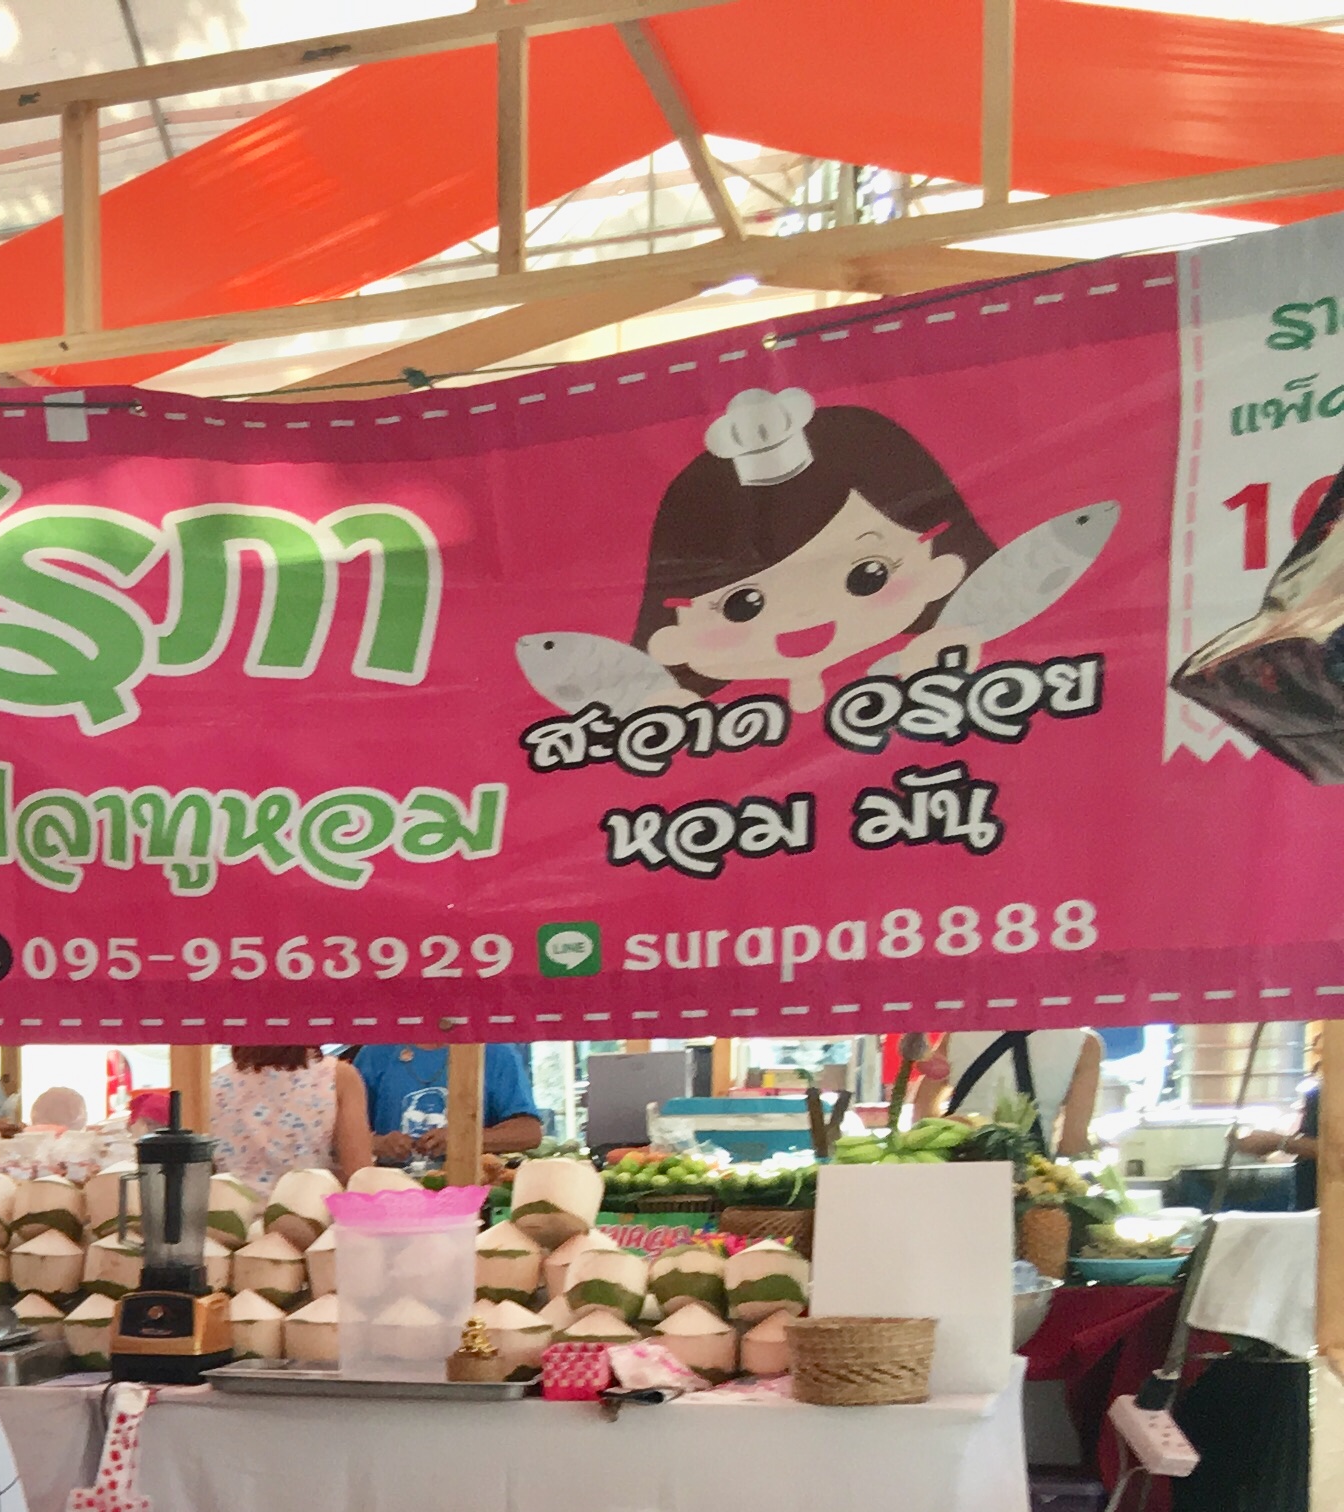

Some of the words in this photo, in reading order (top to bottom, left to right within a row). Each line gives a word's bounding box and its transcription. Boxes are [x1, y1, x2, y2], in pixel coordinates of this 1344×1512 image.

[1265, 294, 1344, 352] รา
[521, 694, 790, 773] สะอาด
[827, 646, 1103, 748] อร่อย
[601, 792, 816, 878] หอม
[853, 759, 1002, 853] มัน
[22, 932, 515, 982] 095-9563929
[622, 898, 1101, 982] surapa8888
